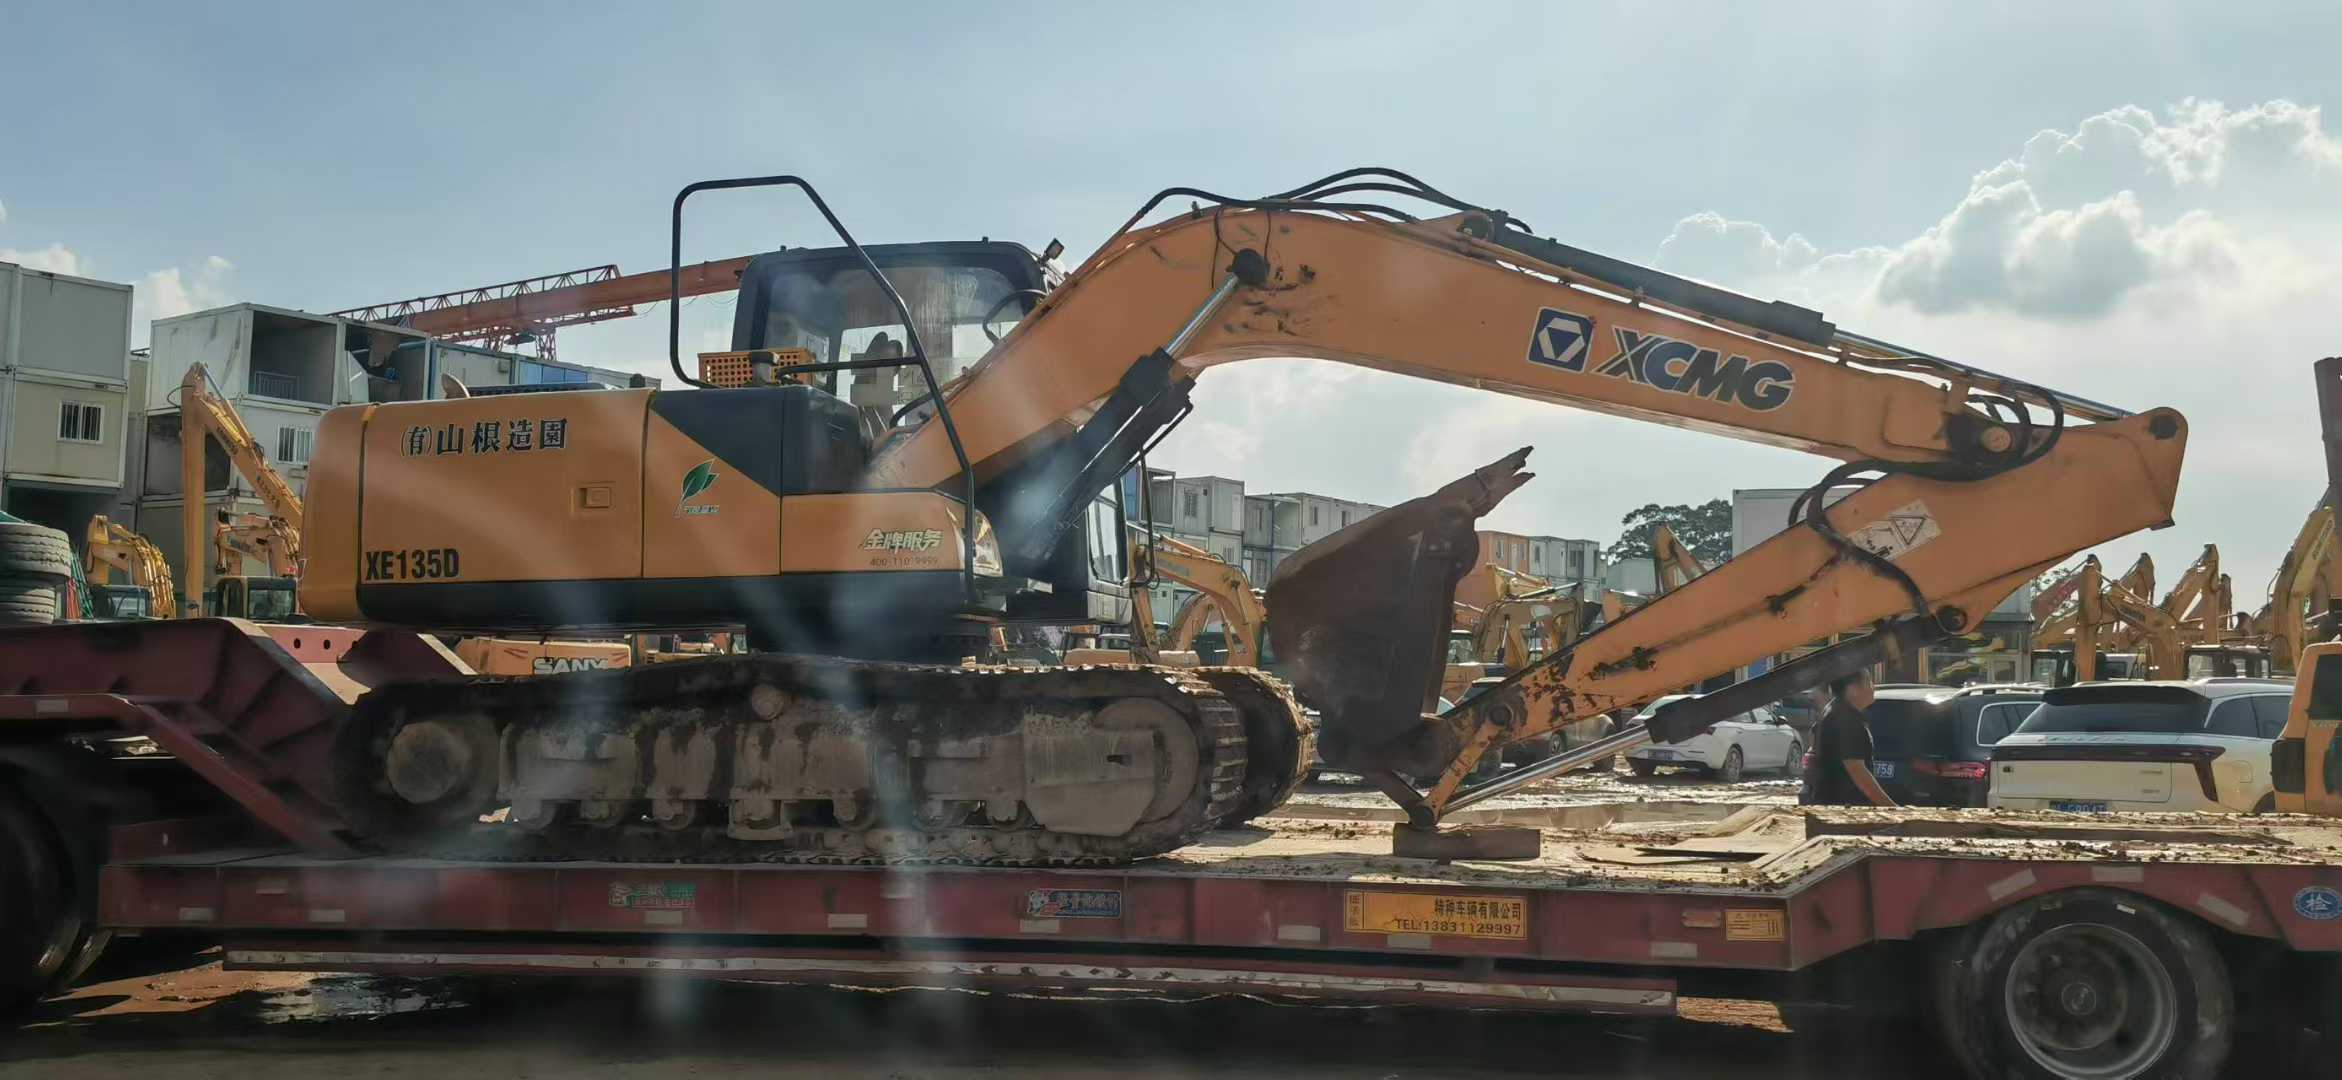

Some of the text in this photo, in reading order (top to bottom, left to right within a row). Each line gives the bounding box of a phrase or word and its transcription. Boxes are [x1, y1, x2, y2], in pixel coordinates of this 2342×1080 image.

[1593, 325, 1796, 412] XCMG
[860, 527, 943, 554] 金牌服务
[365, 548, 460, 580] XE135D
[1434, 897, 1522, 921] 特种车辆有限公司
